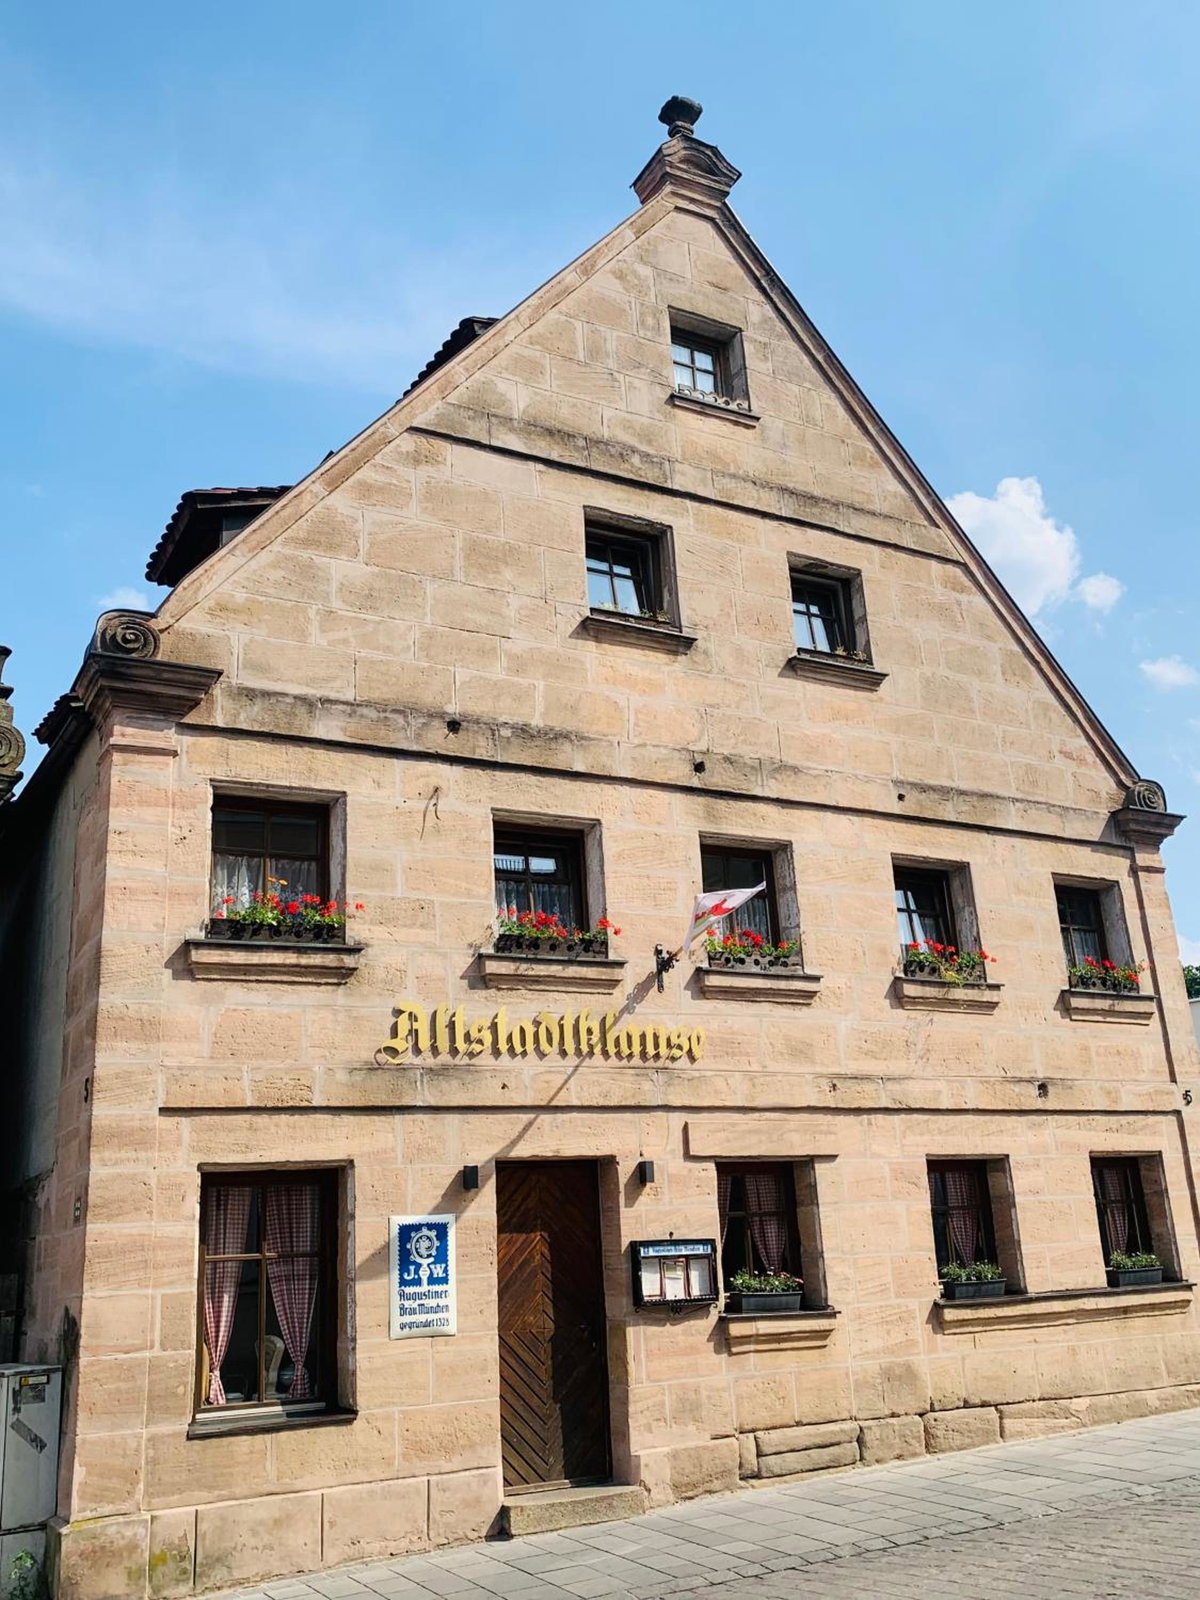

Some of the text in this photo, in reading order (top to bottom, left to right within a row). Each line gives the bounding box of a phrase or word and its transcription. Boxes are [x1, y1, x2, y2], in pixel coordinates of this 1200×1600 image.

[381, 1002, 705, 1064] Altstadtklause
[403, 1264, 446, 1280] J. W.
[398, 1288, 449, 1304] Augustiner
[399, 1303, 450, 1316] Bräu München
[399, 1317, 449, 1331] gegründet 1328
